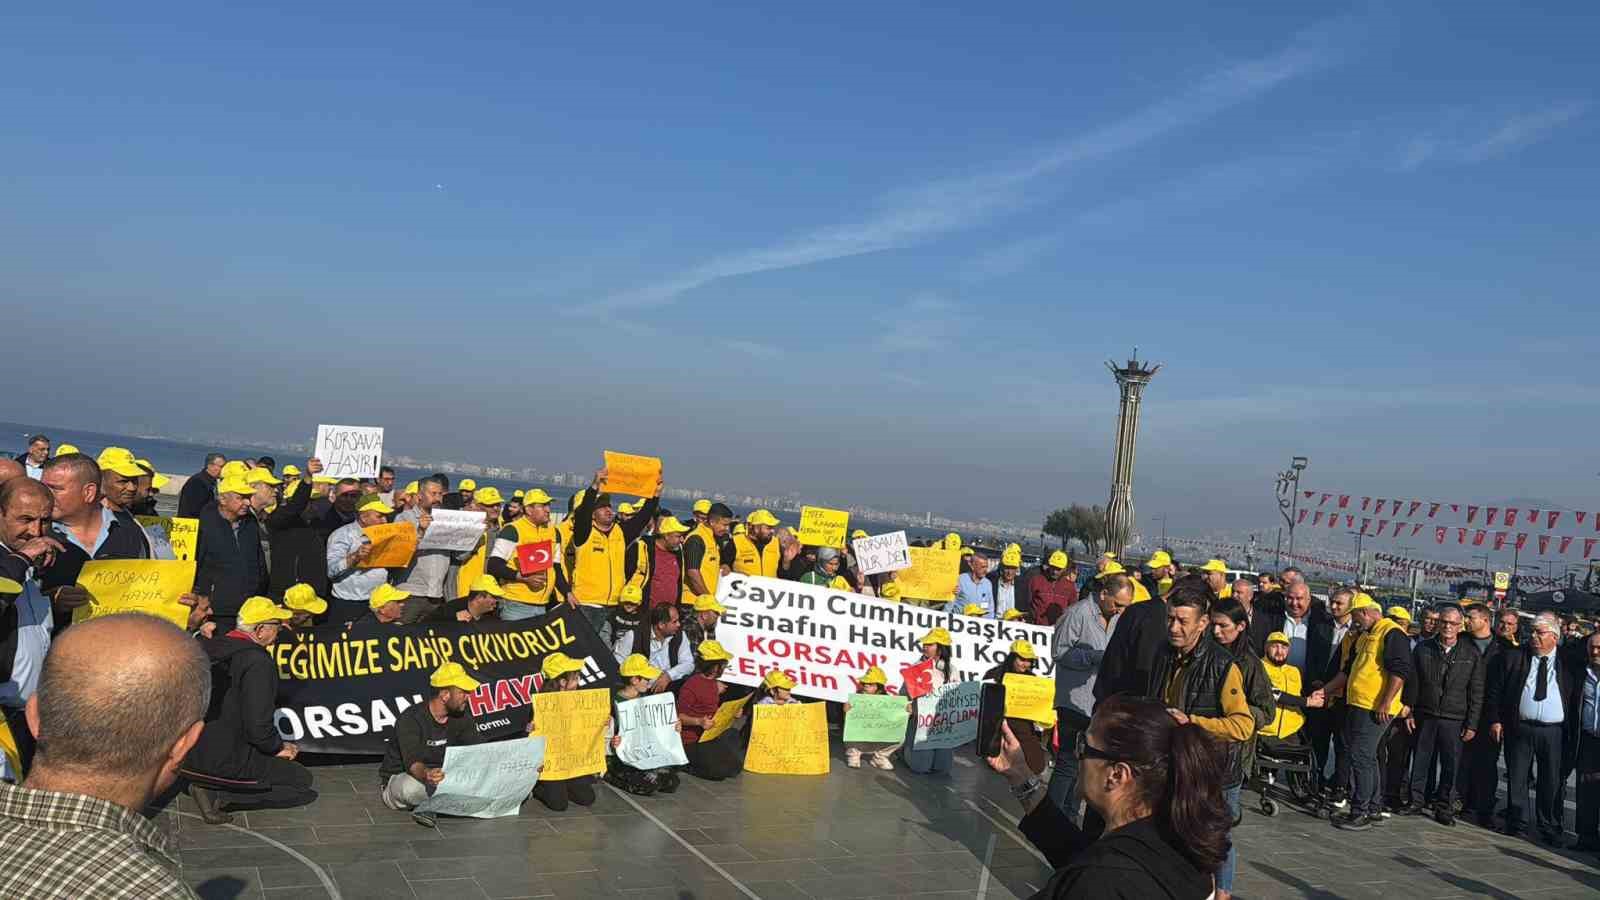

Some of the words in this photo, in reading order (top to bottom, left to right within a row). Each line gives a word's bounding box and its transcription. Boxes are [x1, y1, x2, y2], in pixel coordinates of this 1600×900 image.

[728, 580, 816, 611] Sayın
[720, 605, 837, 641] Esnafın
[266, 632, 384, 680] EĞİMİZE
[387, 629, 454, 672] SAHİP
[458, 617, 576, 671] ÇIKIYORUZ
